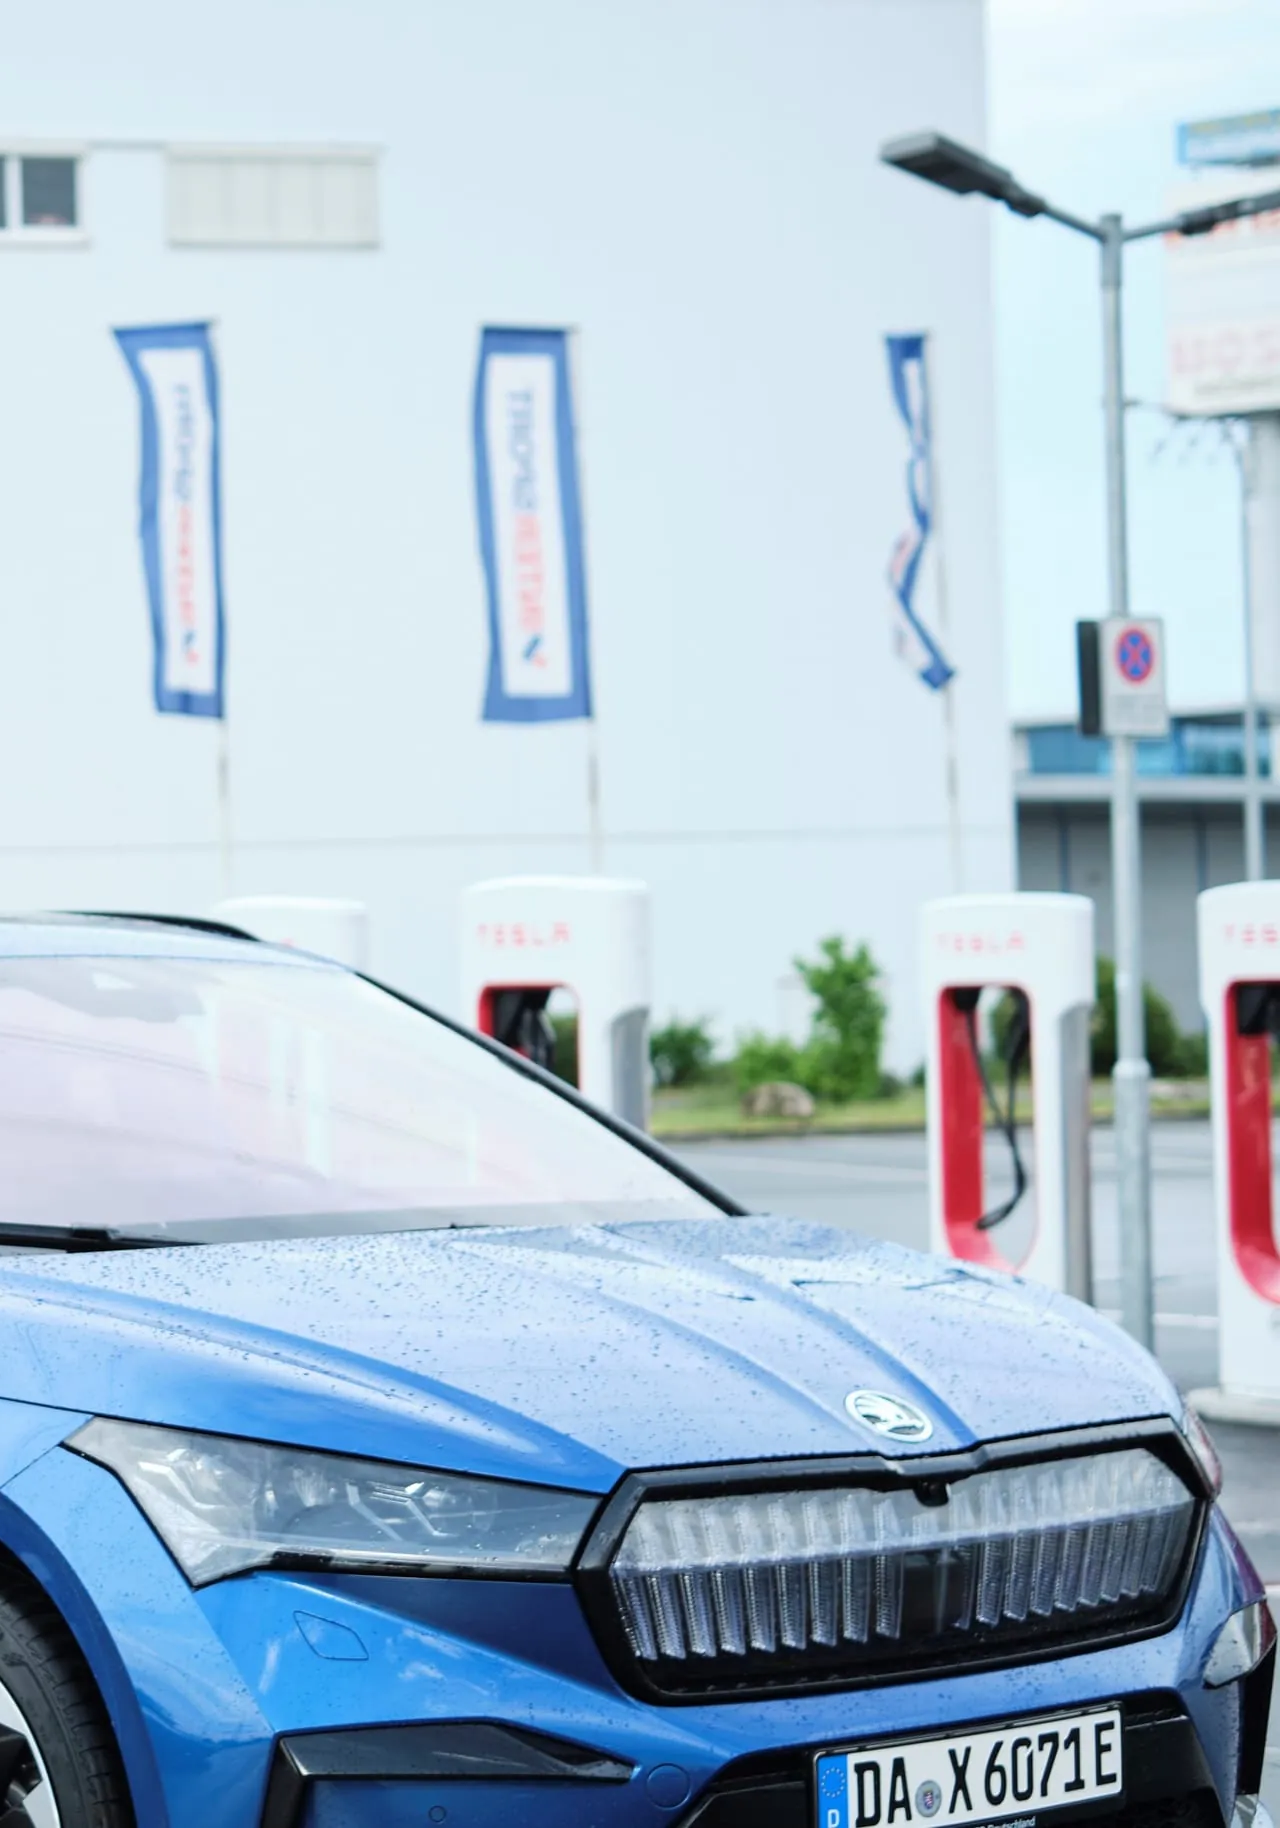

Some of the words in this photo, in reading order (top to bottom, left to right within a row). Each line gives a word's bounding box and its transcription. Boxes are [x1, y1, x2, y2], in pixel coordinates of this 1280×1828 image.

[476, 920, 571, 947] TESLA
[853, 1756, 913, 1828] DA
[947, 1745, 973, 1815] X
[984, 1720, 1119, 1807] 6071E
[827, 1809, 841, 1828] D
